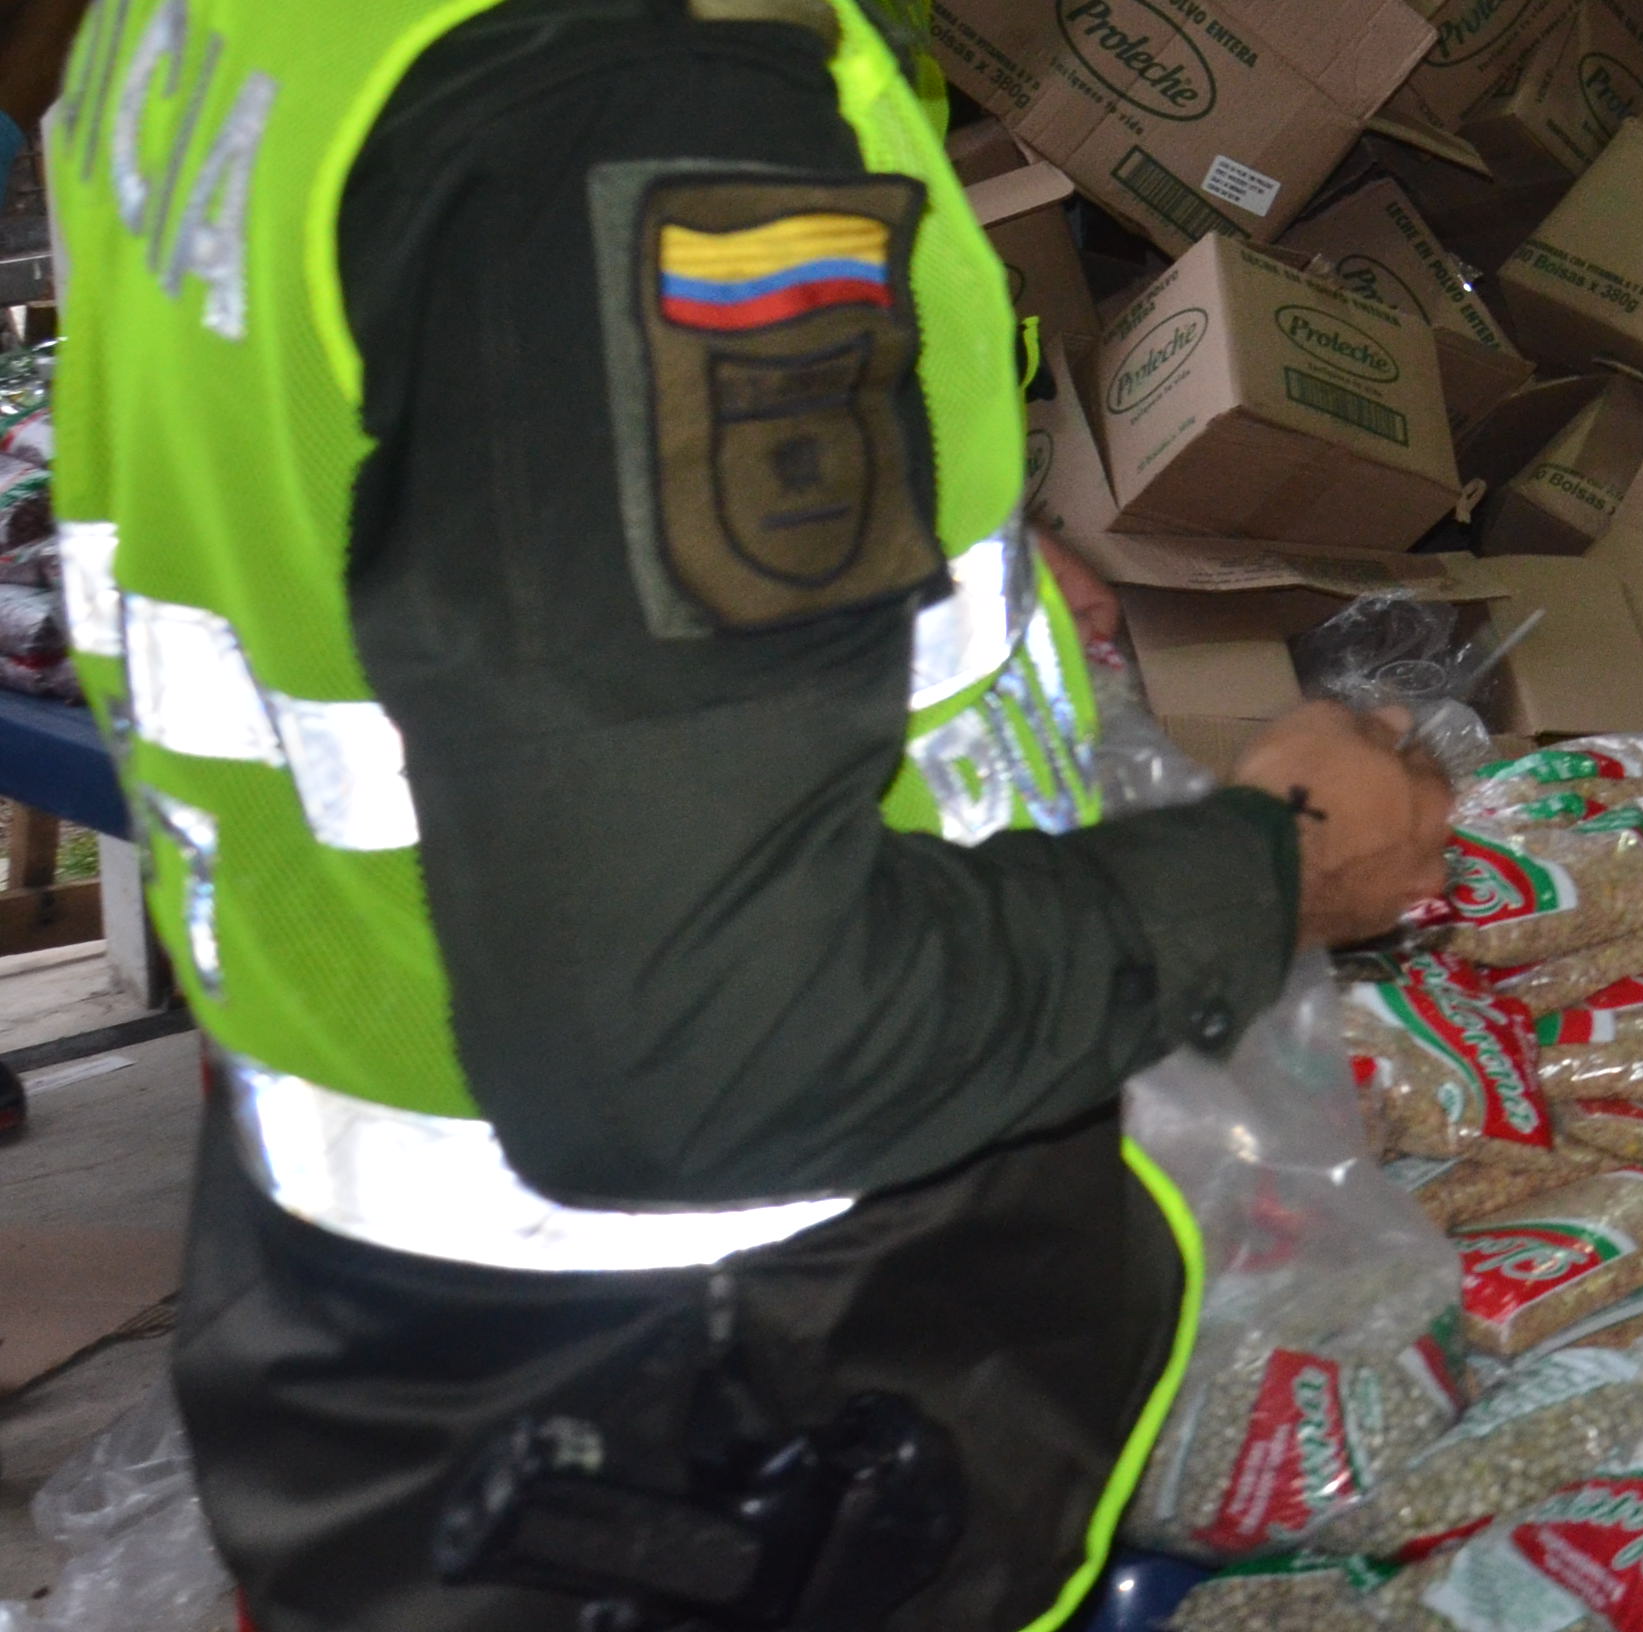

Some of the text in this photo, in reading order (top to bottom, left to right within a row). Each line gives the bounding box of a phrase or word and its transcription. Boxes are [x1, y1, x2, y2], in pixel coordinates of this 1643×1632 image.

[1205, 21, 1266, 71] ENTERA
[985, 67, 1035, 111] 380g
[1426, 257, 1467, 304] POLVO
[1533, 253, 1587, 287] Bolsas
[1586, 280, 1597, 292] x
[1598, 283, 1640, 314] 380g
